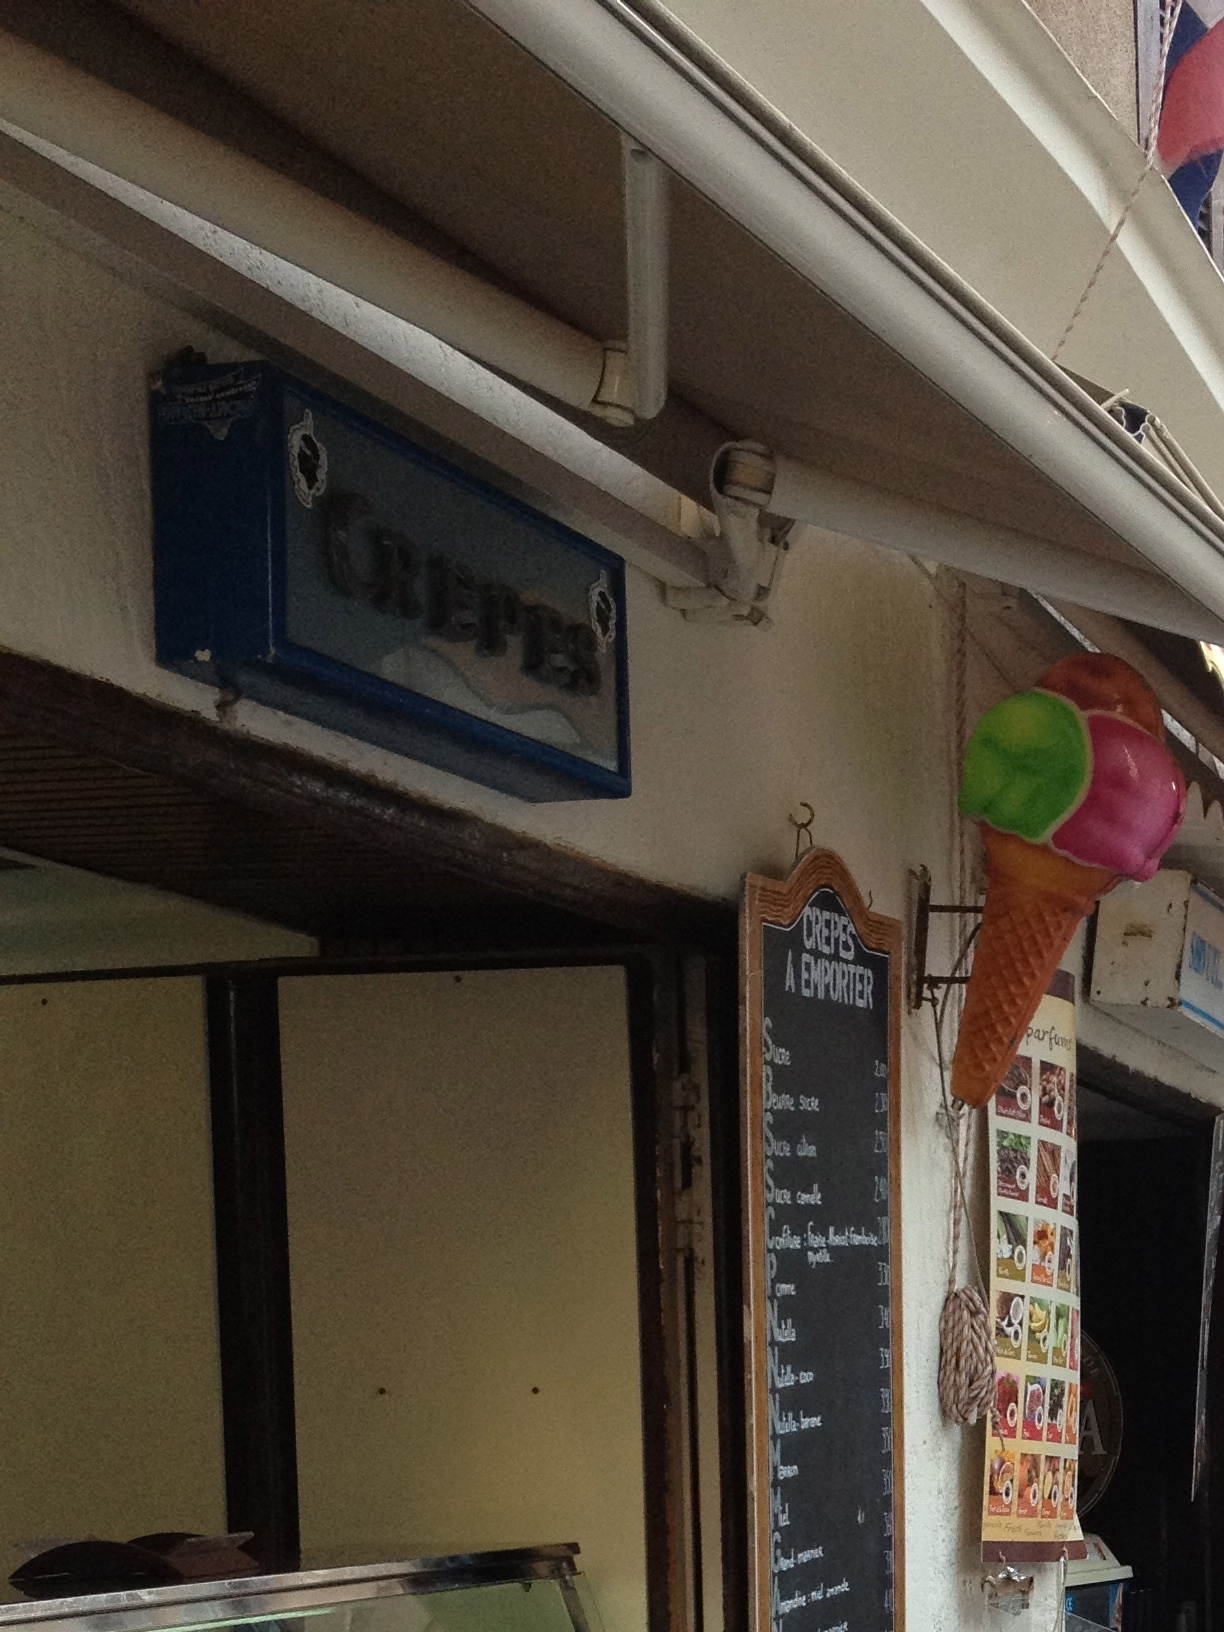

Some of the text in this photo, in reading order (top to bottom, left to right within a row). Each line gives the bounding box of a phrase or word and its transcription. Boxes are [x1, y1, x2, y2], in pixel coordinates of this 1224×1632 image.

[803, 906, 856, 960] CREPES
[801, 952, 874, 1009] EMPORTER
[1026, 1026, 1073, 1051] parfums
